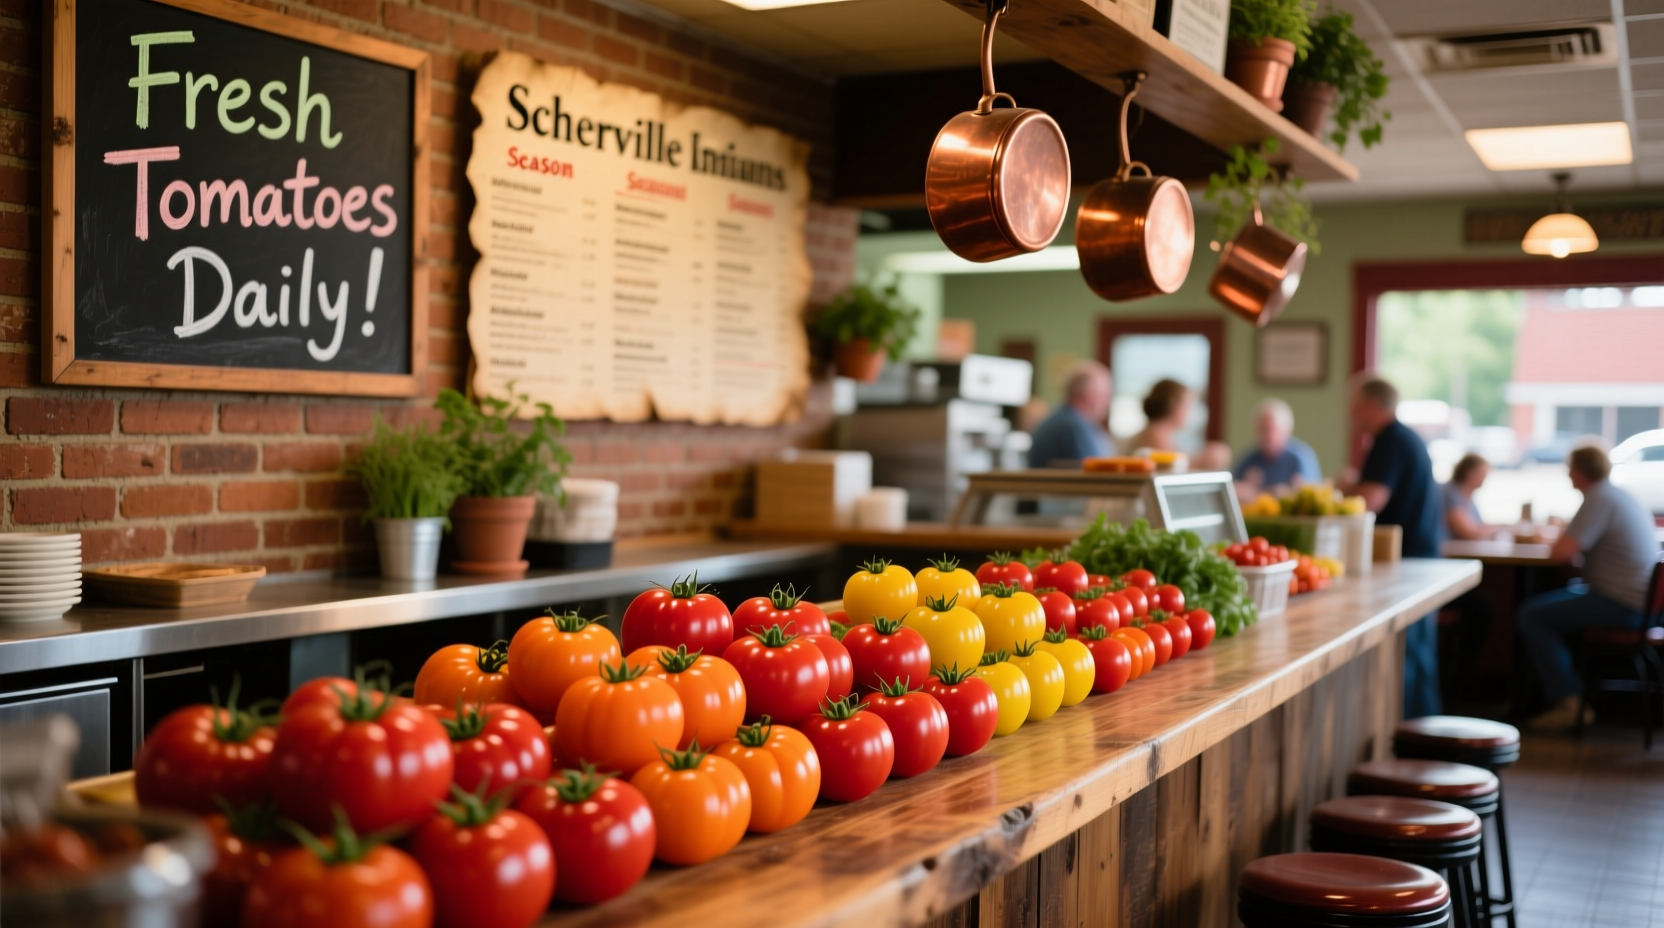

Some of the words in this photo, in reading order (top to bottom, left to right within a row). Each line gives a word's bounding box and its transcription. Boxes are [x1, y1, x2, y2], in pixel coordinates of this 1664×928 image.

[128, 30, 343, 149] Fresh
[507, 83, 683, 168] Scherville
[104, 146, 398, 241] Tomatoes
[507, 146, 574, 178] Season
[167, 246, 384, 361] Daily!
